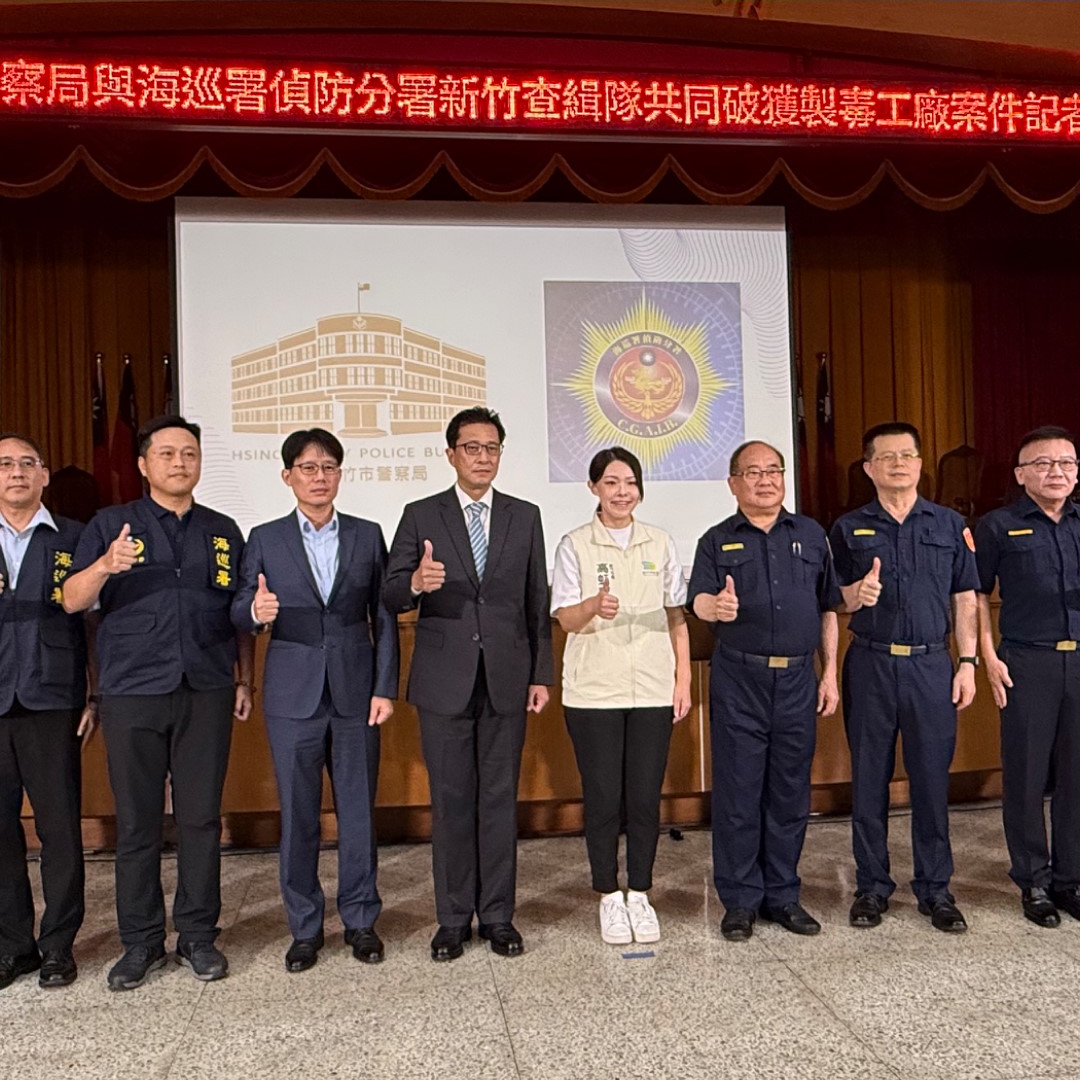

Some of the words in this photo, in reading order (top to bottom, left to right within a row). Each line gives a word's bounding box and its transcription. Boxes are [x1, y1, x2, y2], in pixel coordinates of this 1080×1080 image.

[232, 449, 282, 461] HSINC
[360, 447, 415, 459] POLICE
[343, 465, 428, 482] 竹市警察局
[213, 536, 231, 586] 海巡署
